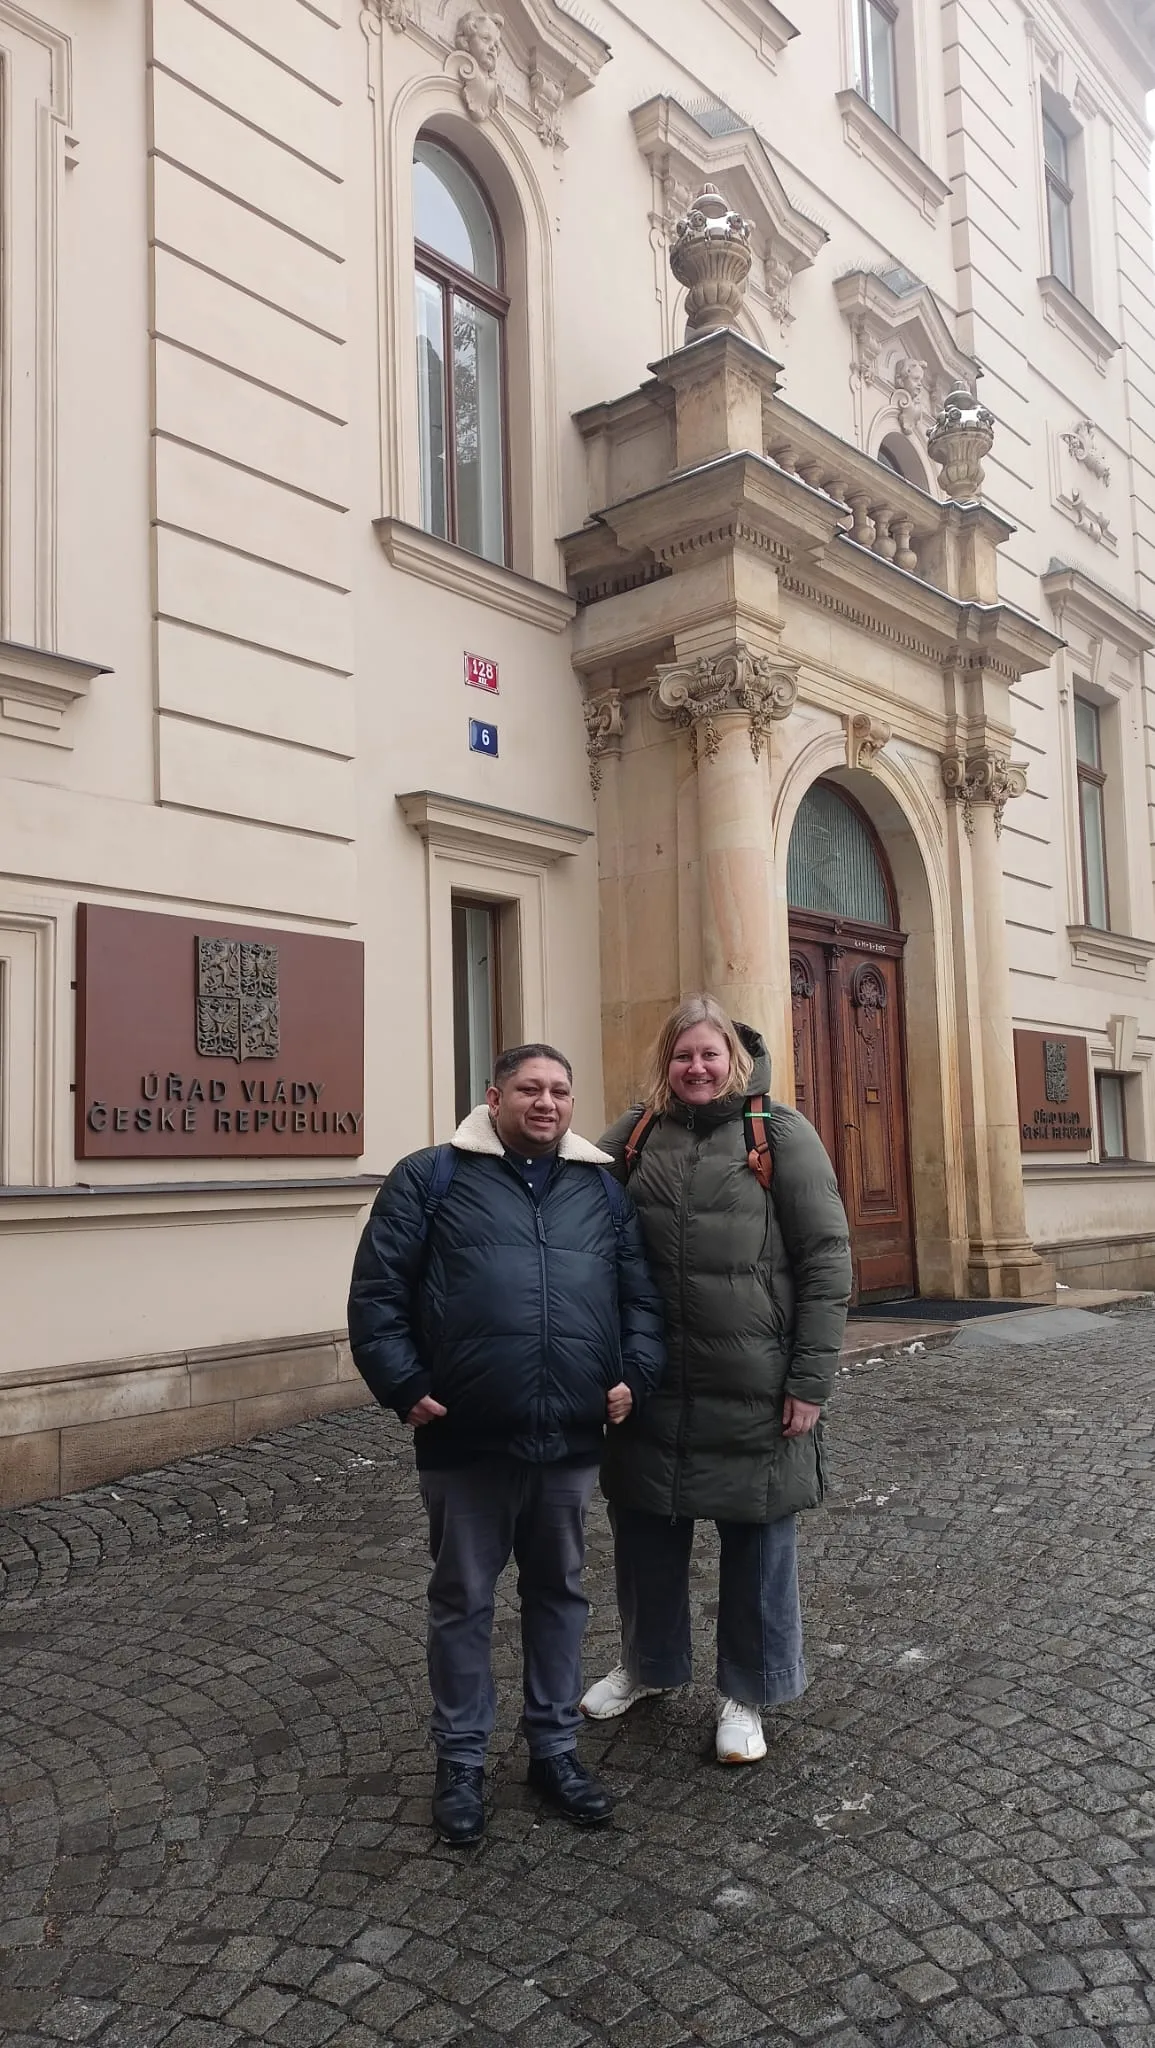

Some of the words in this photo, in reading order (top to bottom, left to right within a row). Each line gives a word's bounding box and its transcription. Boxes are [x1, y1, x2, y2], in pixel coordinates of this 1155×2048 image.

[473, 659, 494, 680] 128
[481, 728, 490, 746] 6
[142, 1072, 227, 1102] ÚŘAD
[241, 1076, 326, 1105] VLÁDY
[87, 1101, 198, 1133] ČESKÉ
[213, 1108, 364, 1134] REPUBLIKY
